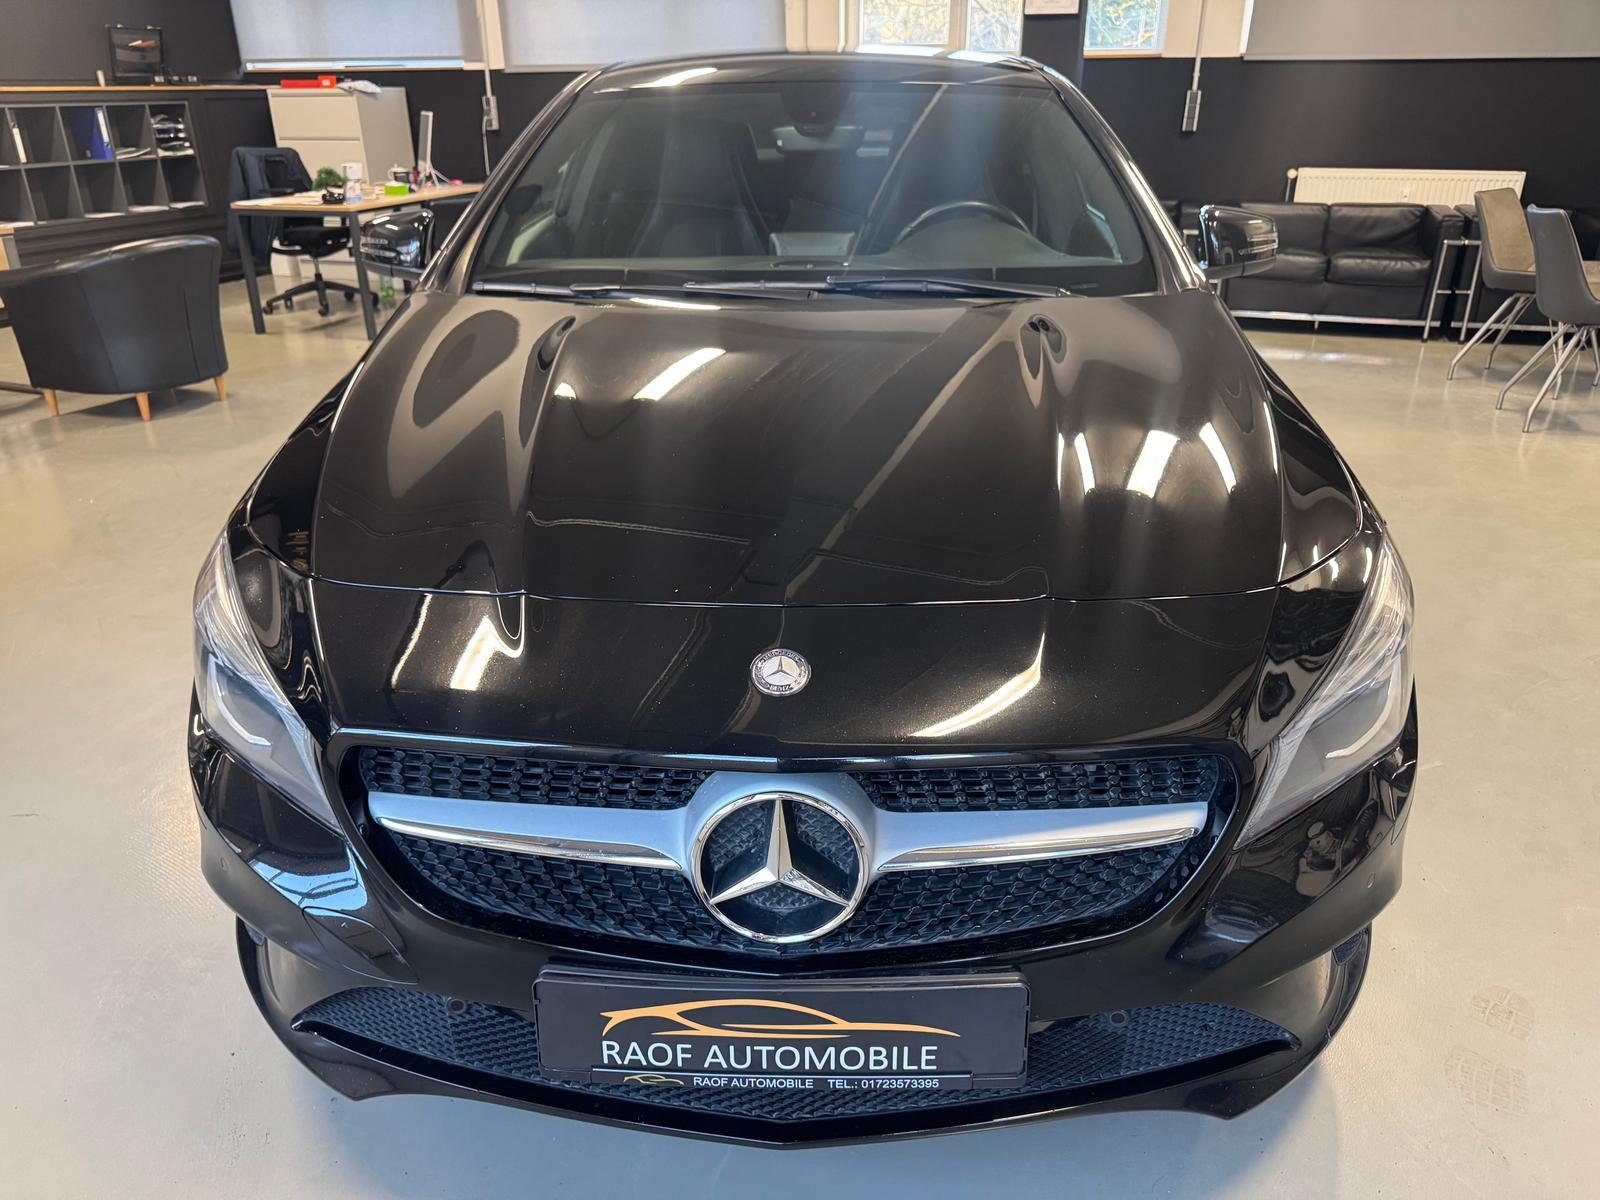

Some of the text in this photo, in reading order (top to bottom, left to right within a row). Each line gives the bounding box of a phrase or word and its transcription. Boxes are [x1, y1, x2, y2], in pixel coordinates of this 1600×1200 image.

[601, 1040, 938, 1071] RAOF AUTOMOBILE
[693, 1076, 940, 1089] RAOF AUTOMOBILE TEL.: 01723573395
